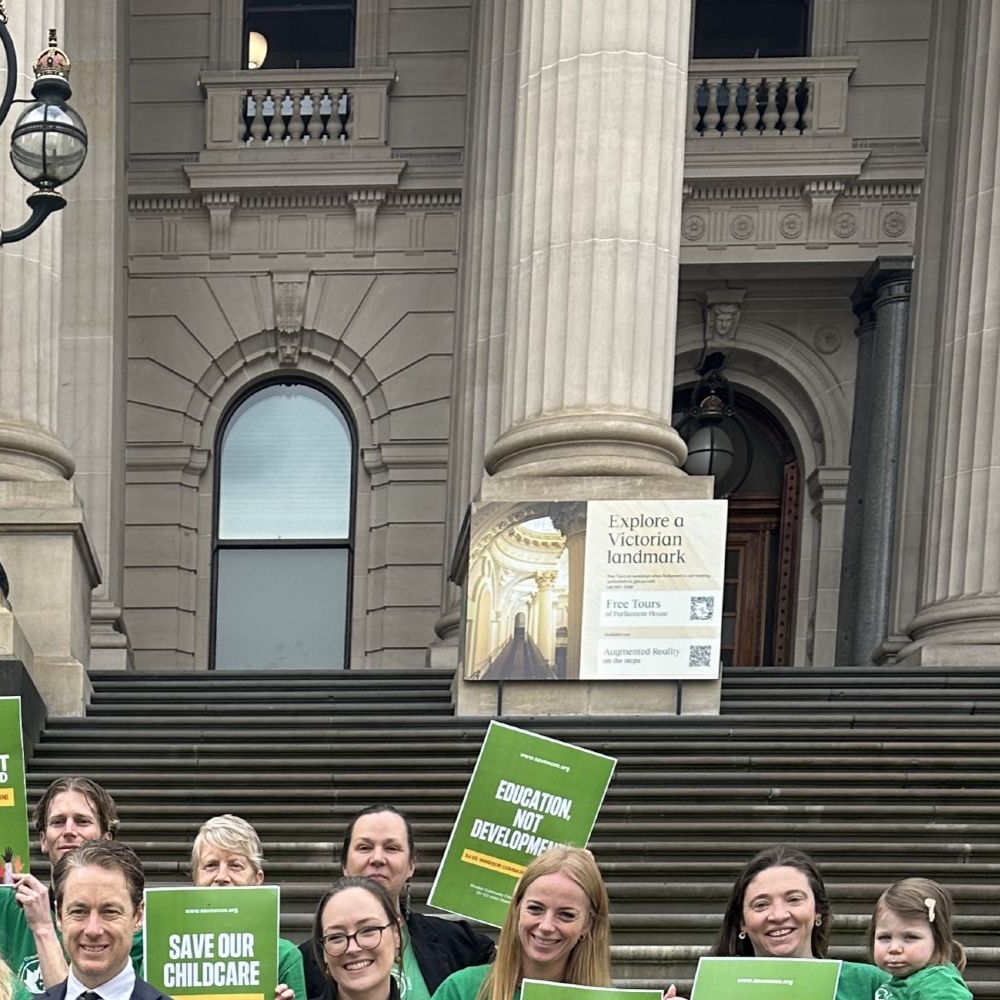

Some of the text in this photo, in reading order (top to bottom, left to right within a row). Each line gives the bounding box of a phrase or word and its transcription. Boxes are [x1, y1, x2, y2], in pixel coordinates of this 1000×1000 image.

[609, 514, 684, 531] Explore a
[609, 532, 682, 546] Victorian
[607, 550, 685, 564] landmark
[606, 599, 661, 608] Free Tours
[604, 647, 680, 656] Augmented Reality
[495, 780, 573, 820] EDUCATION,
[512, 809, 544, 833] NOT
[169, 933, 254, 959] SAVE OUR
[164, 961, 259, 988] CHILDCARE
